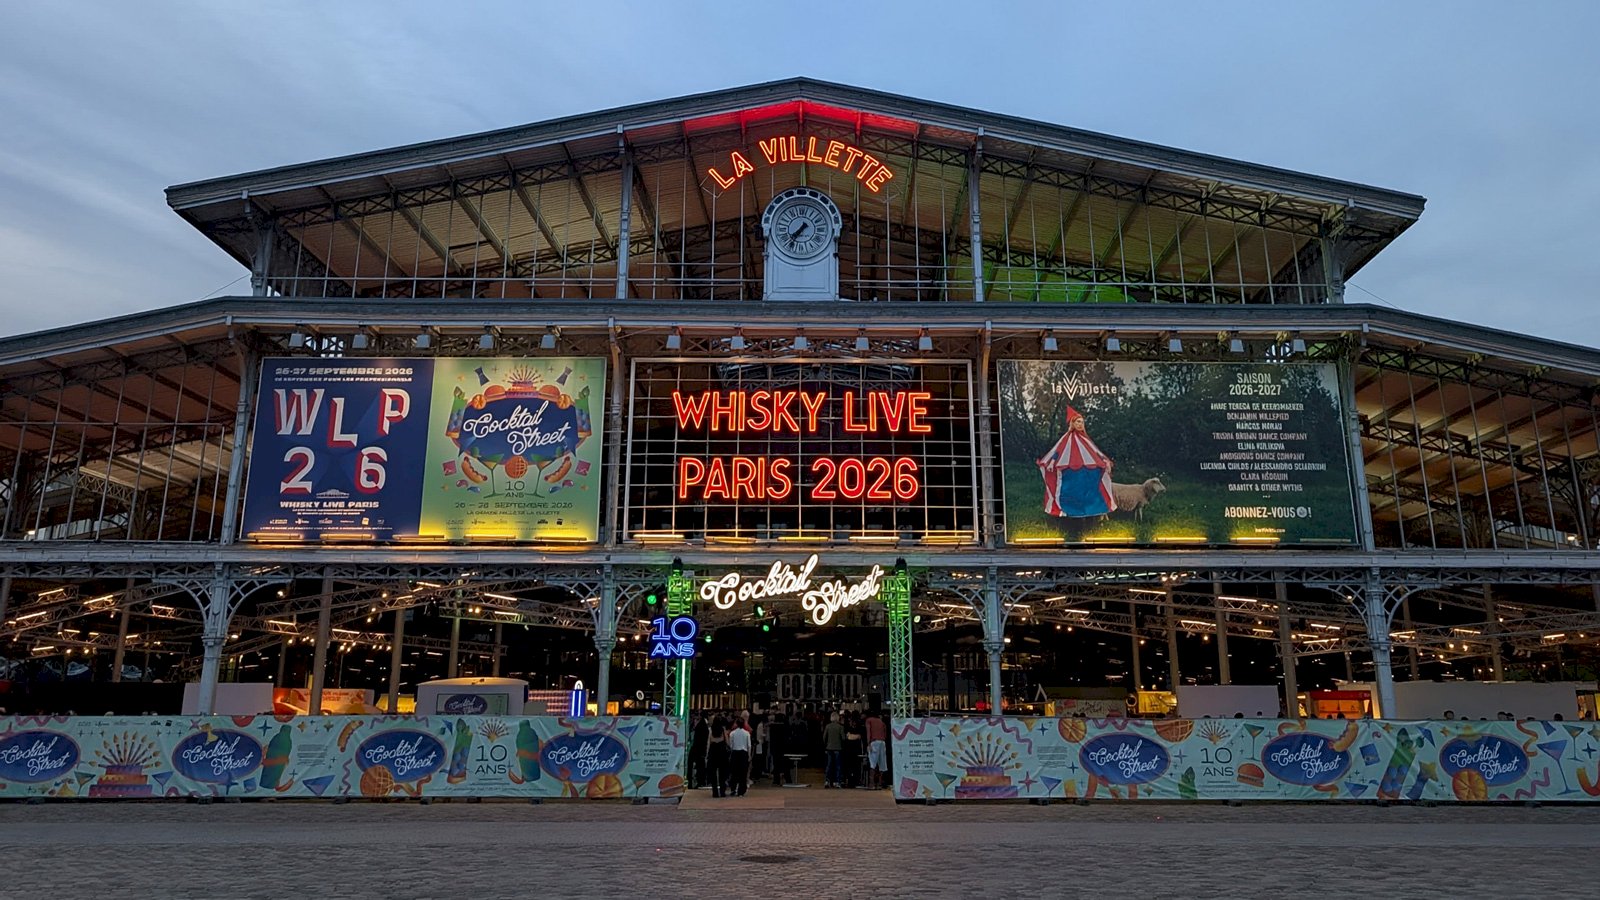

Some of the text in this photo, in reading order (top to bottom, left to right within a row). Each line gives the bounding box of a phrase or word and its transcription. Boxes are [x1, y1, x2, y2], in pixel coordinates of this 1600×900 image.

[708, 136, 893, 193] LA VILLETTE
[1229, 384, 1282, 396] 2026-2027
[1236, 373, 1272, 383] SAISON
[463, 400, 548, 438] Cocktail
[673, 391, 932, 432] WHISKY LIVE
[507, 422, 571, 455] Street
[505, 481, 525, 491] 10
[679, 457, 918, 499] PARIS 2026
[1224, 507, 1296, 518] ABONNEZ-VOUS
[700, 554, 884, 626] Cocktail Street
[652, 617, 696, 641] 10
[652, 642, 695, 656] ANS
[782, 675, 860, 698] COCKTAIL
[0, 736, 57, 764] Cocktail
[182, 736, 240, 764] Cocktail
[366, 736, 423, 763] Cocktail
[476, 745, 507, 761] 10
[548, 737, 604, 764] Cocktail
[1089, 739, 1143, 766] Cocktail
[1200, 748, 1232, 764] 10
[1271, 739, 1324, 766] Cocktail
[1450, 741, 1500, 768] Cocktail
[28, 752, 71, 776] Street
[210, 752, 254, 776] Street
[394, 751, 436, 775] Street
[475, 764, 507, 775] ANS
[577, 753, 619, 776] Street
[1118, 755, 1160, 778] Street
[1203, 767, 1234, 777] ANS
[1301, 755, 1341, 778] Street
[1480, 757, 1520, 780] Street
